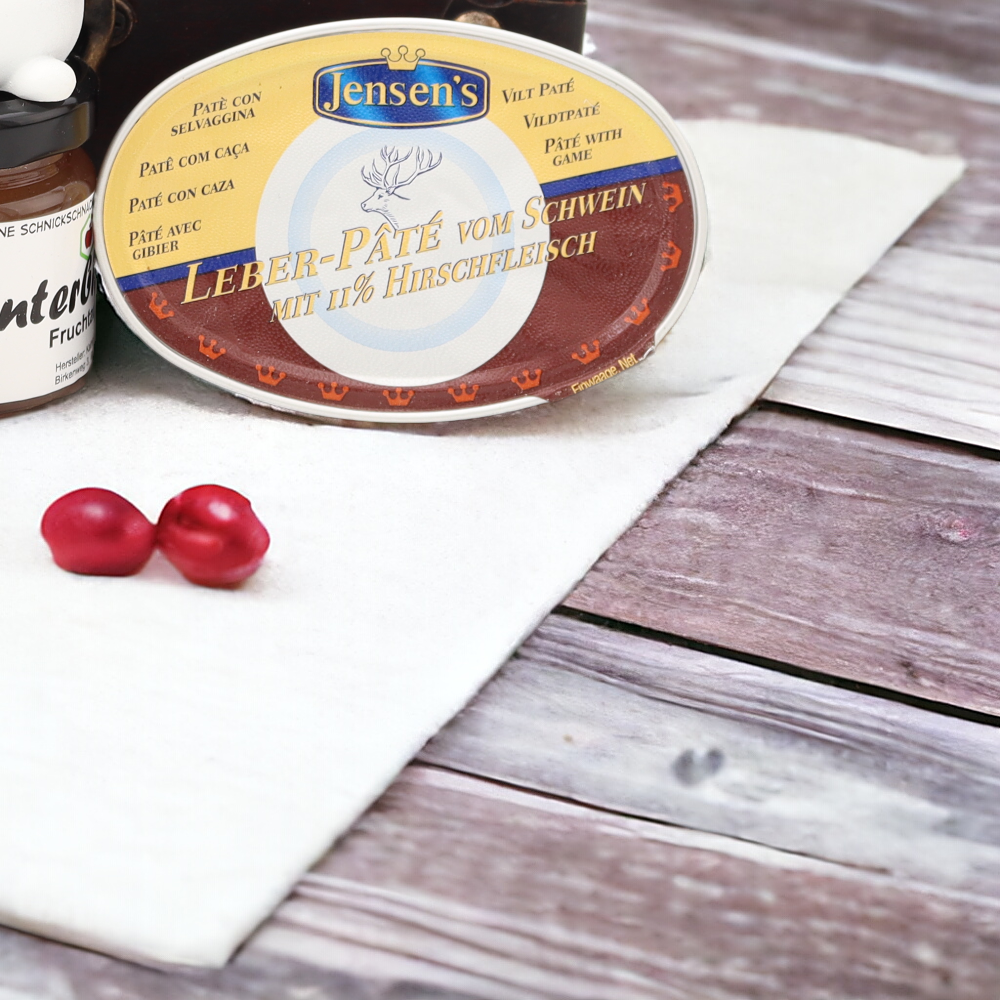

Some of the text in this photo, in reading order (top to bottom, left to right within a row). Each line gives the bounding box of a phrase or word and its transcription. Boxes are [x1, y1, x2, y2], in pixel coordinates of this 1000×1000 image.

[324, 71, 479, 111] Jensen's
[170, 107, 256, 137] SELVAGGINA
[178, 150, 210, 168] COM
[552, 149, 593, 167] GAME
[167, 187, 197, 204] CON
[201, 179, 235, 196] CAZA
[457, 211, 515, 241] VOM
[522, 182, 647, 230] SCHWEIN
[167, 219, 202, 237] AVEC
[132, 240, 179, 260] GIBIER
[270, 293, 323, 324] MIT
[384, 230, 598, 300] HIRSCHFLEISCH
